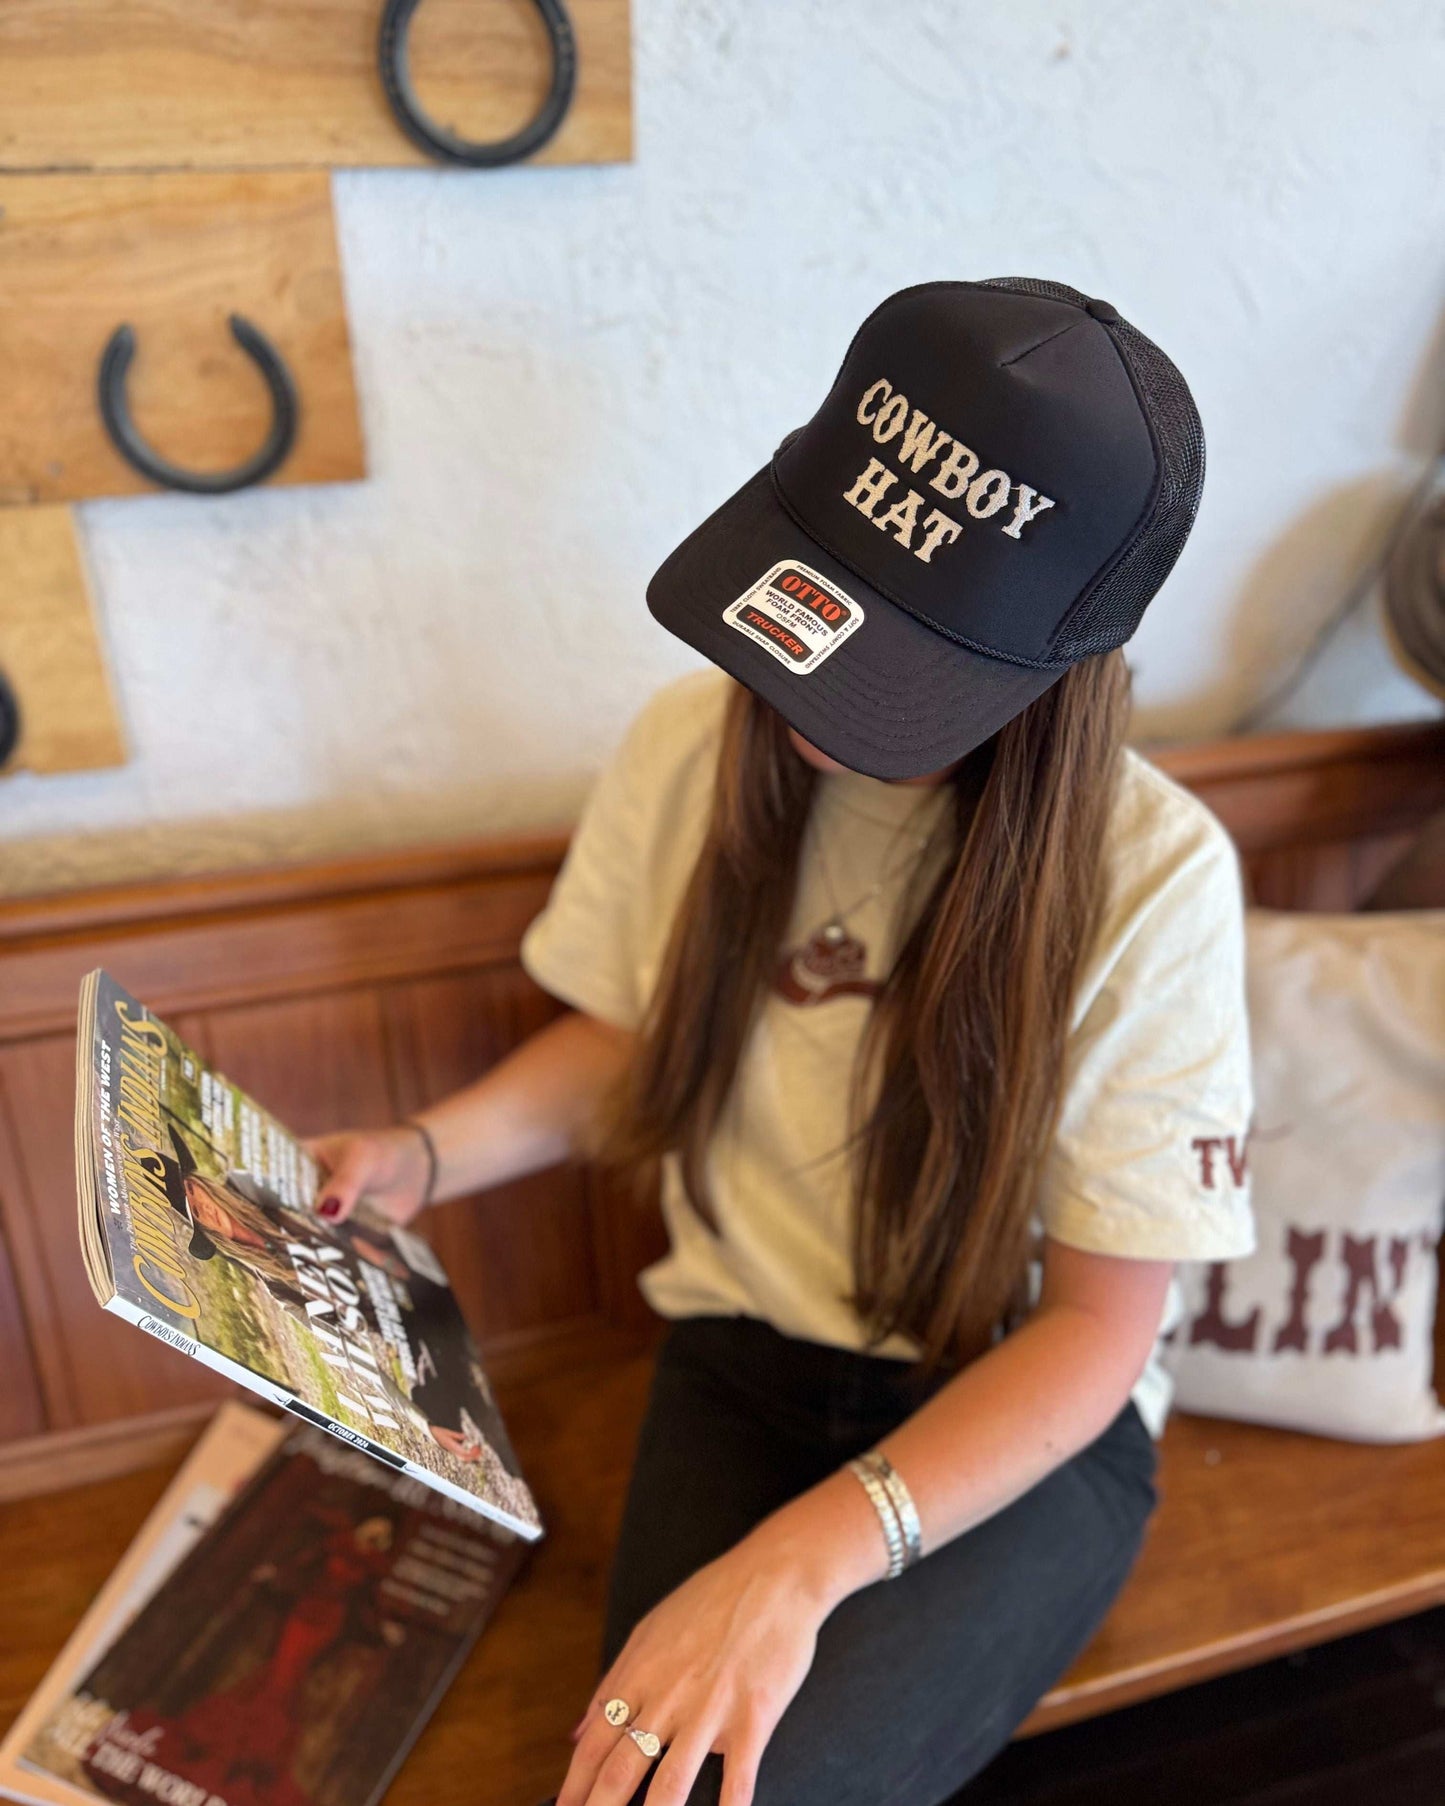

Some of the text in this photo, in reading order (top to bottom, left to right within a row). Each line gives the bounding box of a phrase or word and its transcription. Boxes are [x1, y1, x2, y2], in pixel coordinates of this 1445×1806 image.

[856, 377, 1056, 540] COWBOY
[842, 456, 964, 564] HAT
[742, 590, 757, 603] CLOTH
[756, 567, 782, 591] SWEATBAND
[781, 575, 841, 621] OTTO
[797, 564, 853, 606] PREMIUM FOAM FABRIC
[746, 611, 804, 655] TRUCKER
[765, 589, 829, 637] WORLD FAMOUS
[766, 598, 819, 636] FOAM FRONT
[776, 613, 797, 628] OSFM
[732, 620, 791, 664] DURABLE SNAP CLOSURE
[804, 645, 830, 669] SWEATBAND
[829, 631, 845, 647] COMFY
[100, 1039, 121, 1215] WOMEN OF THE WEST
[114, 999, 201, 1320] COWBOYS INDIANS
[327, 1422, 356, 1441] OCTOBER
